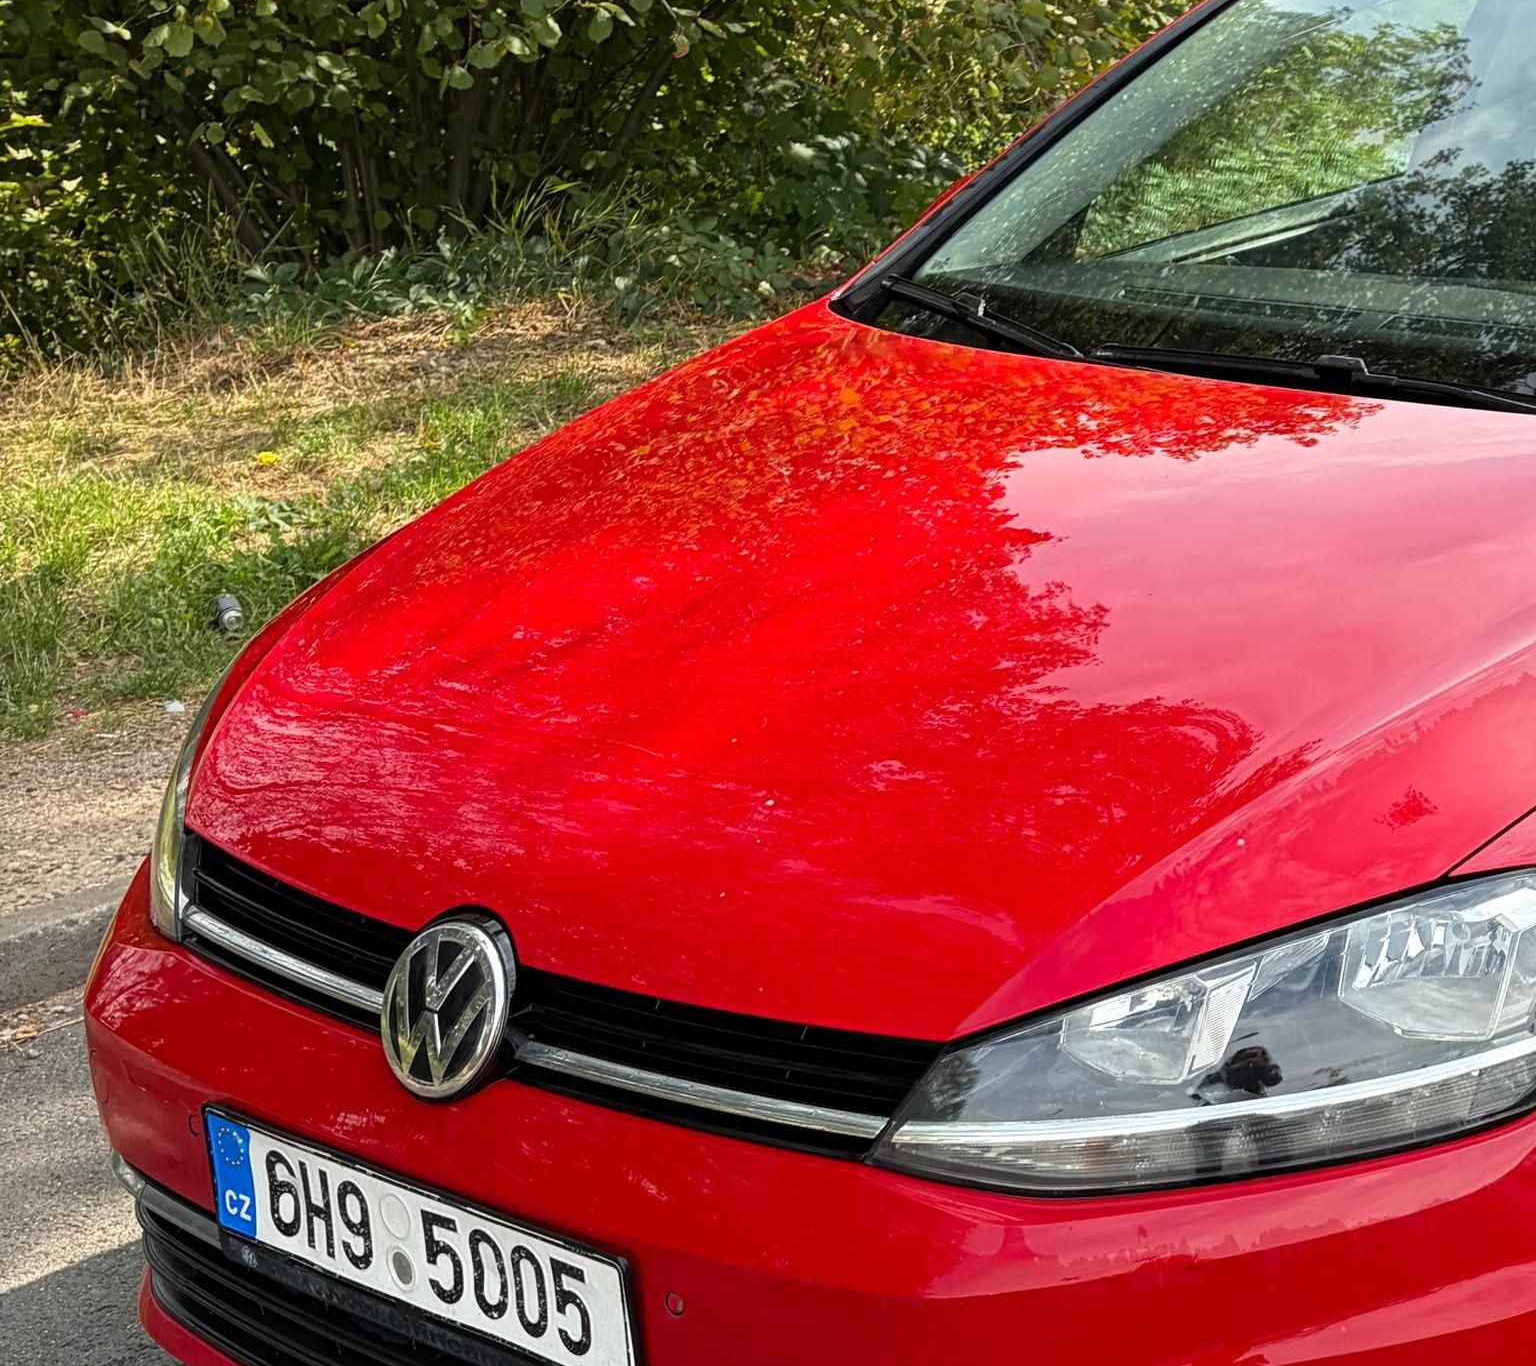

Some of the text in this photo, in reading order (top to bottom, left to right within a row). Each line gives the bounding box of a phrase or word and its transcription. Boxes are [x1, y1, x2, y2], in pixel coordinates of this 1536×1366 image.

[225, 1188, 252, 1223] CZ
[264, 1149, 593, 1357] 6H9 5005
